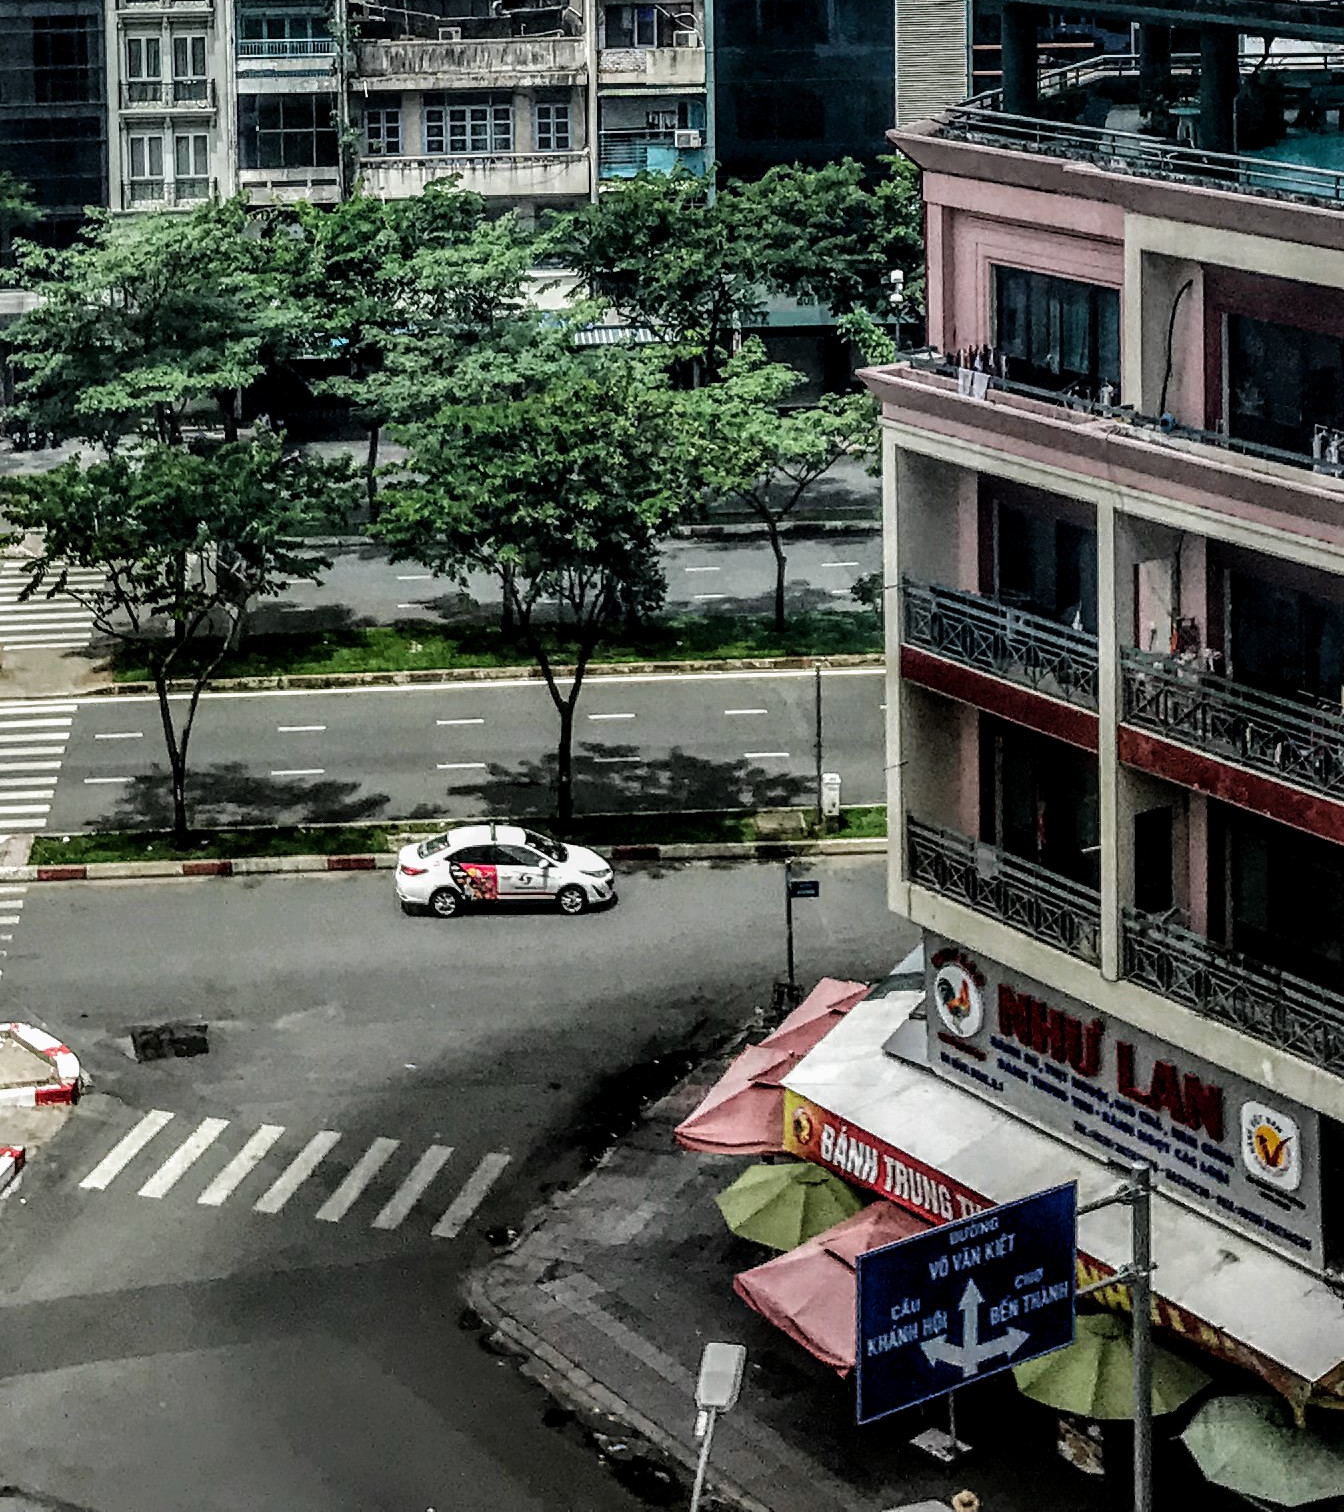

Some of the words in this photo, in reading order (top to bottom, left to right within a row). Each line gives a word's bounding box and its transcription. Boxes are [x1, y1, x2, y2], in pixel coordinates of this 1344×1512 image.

[997, 983, 1106, 1079] NHƯ
[1114, 1041, 1225, 1145] LAN
[820, 1124, 879, 1185] BÁNH
[883, 1153, 954, 1221] TRUNG
[952, 1245, 981, 1272] VĂN
[866, 1322, 919, 1357] KHÁNH
